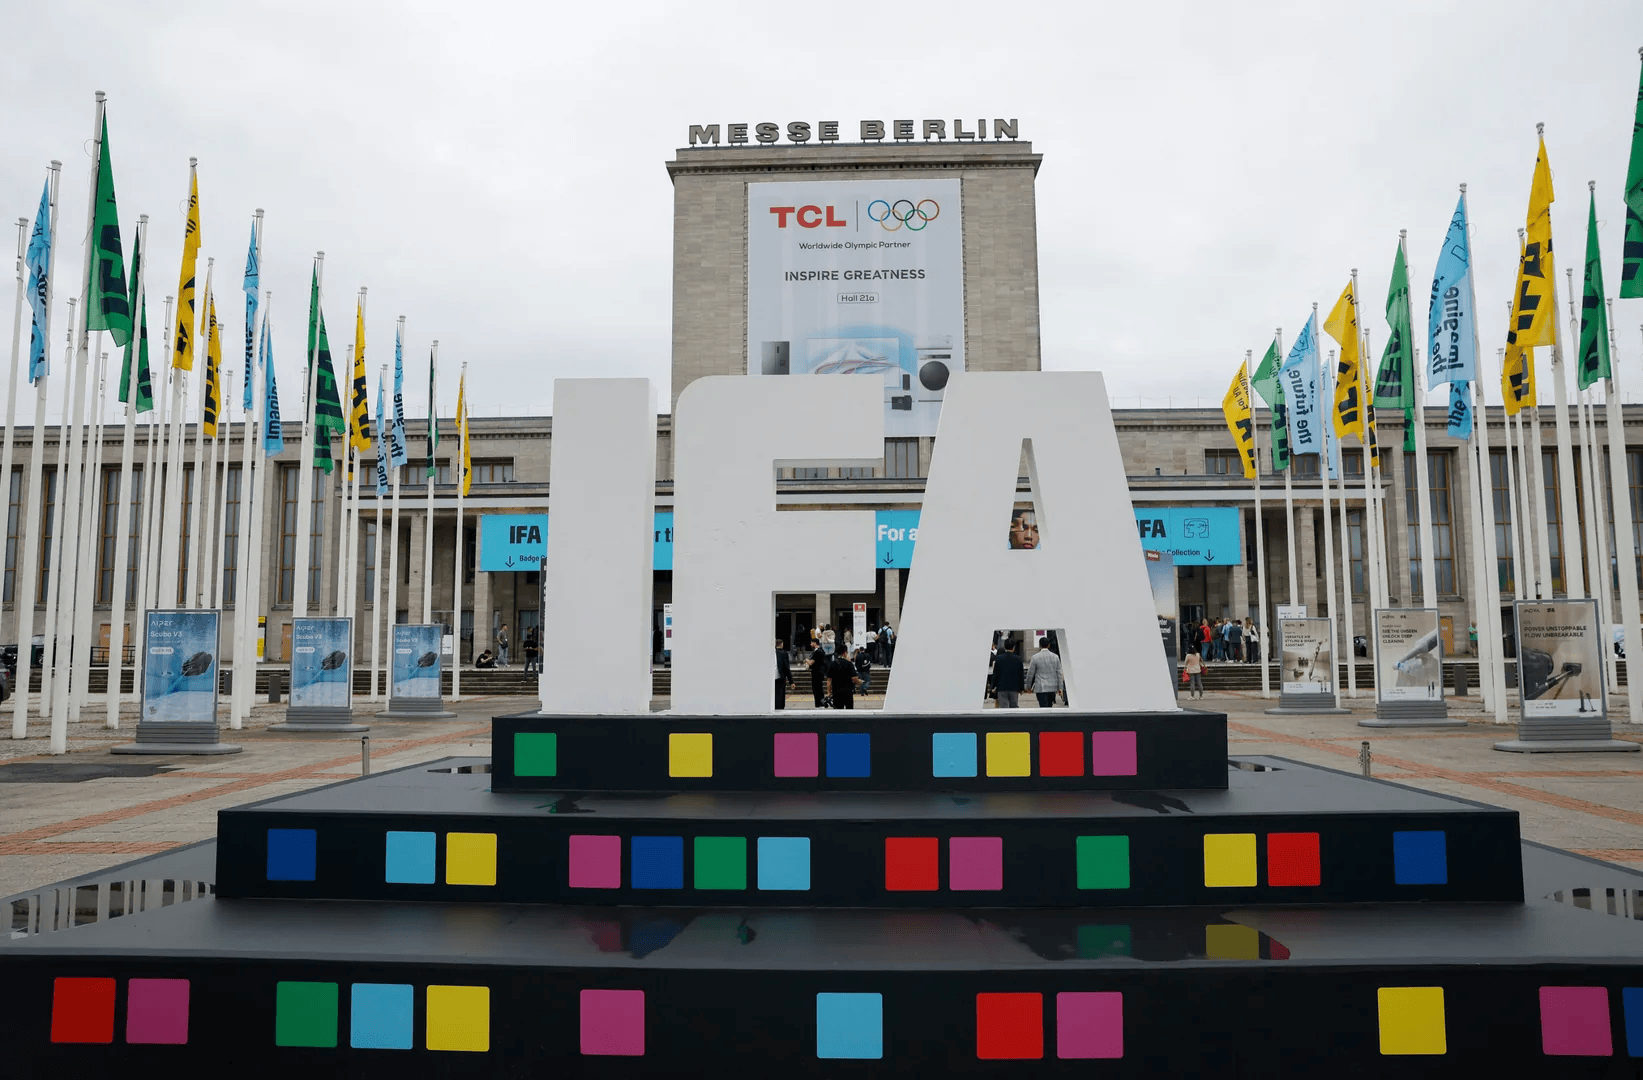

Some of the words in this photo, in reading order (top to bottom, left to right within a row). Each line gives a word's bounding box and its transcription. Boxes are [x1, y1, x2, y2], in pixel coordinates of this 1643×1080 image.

[689, 121, 839, 144] MESSE
[860, 119, 1018, 140] BERLIN
[769, 205, 847, 228] TCL
[799, 242, 843, 250] Worldwide
[844, 241, 878, 250] Olympic
[879, 241, 911, 249] Partner
[785, 270, 839, 281] INSPIRE
[843, 269, 926, 281] GREATNESS
[509, 525, 542, 544] IFA
[877, 524, 905, 541] For
[908, 528, 918, 541] a
[540, 371, 1177, 715] IFA
[519, 555, 540, 563] Badge
[150, 630, 172, 638] Scuba
